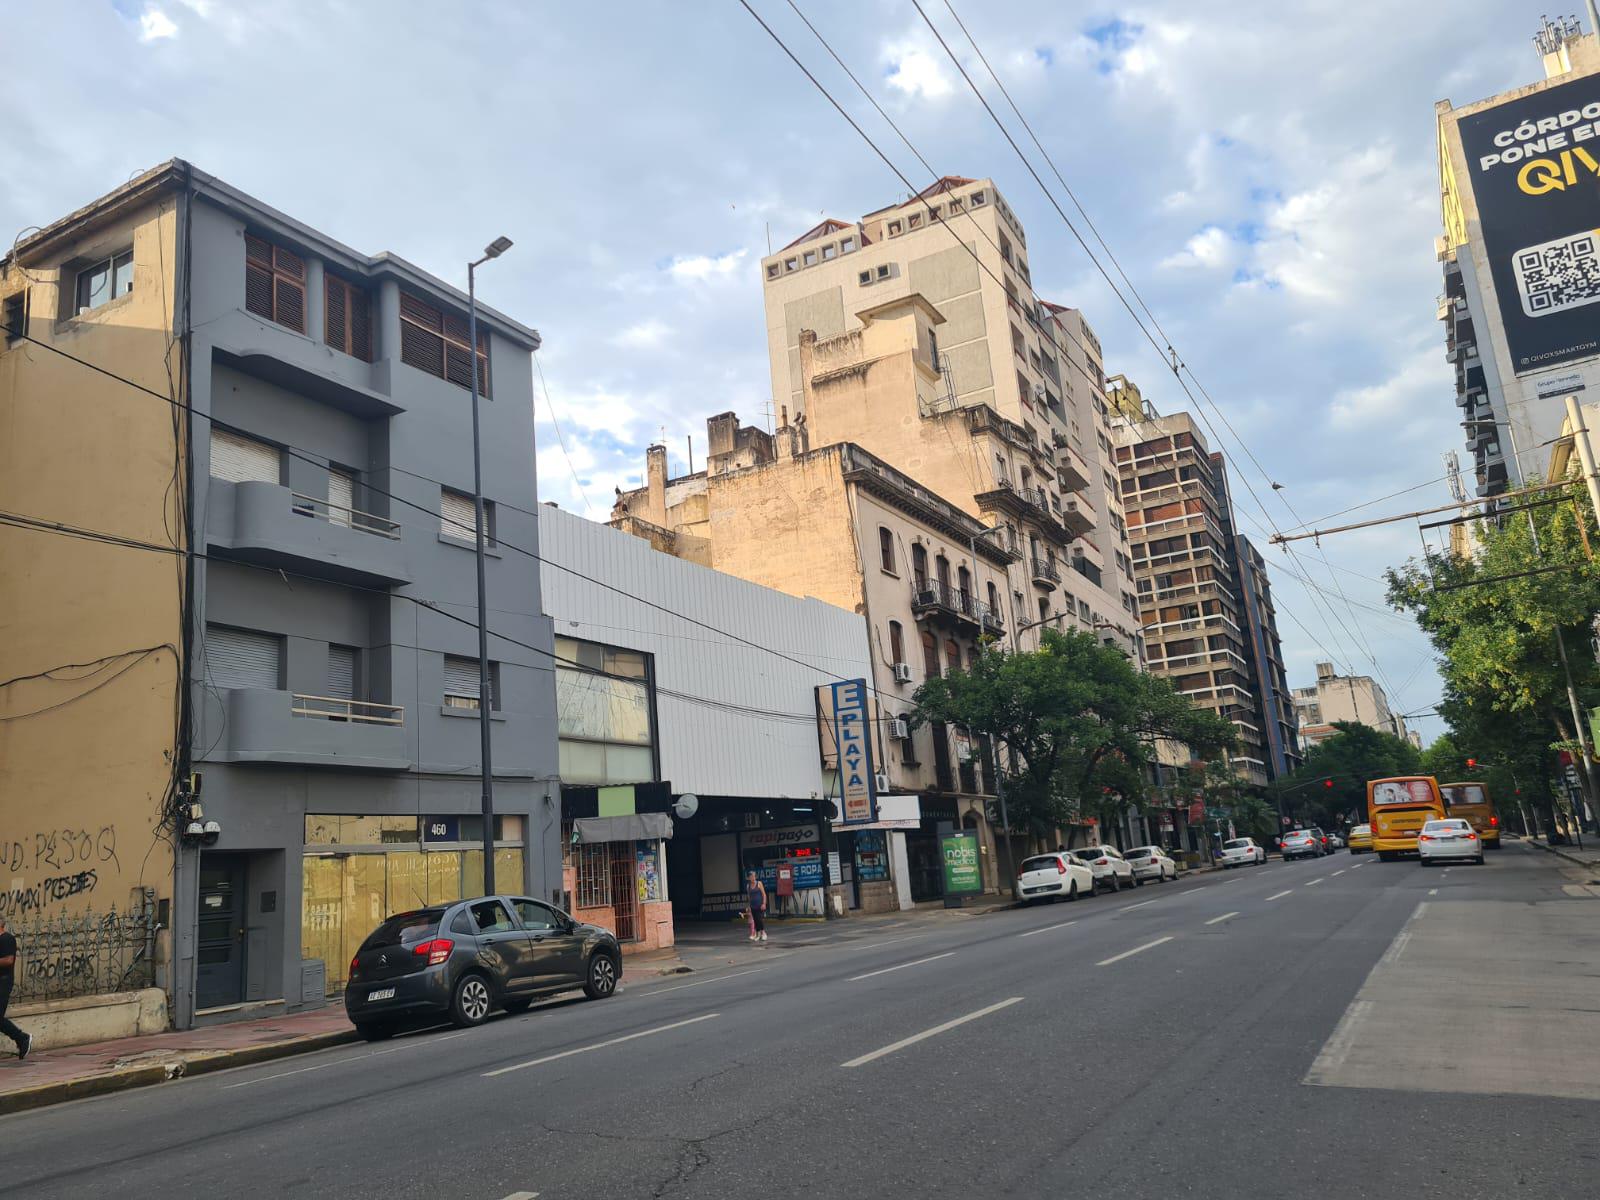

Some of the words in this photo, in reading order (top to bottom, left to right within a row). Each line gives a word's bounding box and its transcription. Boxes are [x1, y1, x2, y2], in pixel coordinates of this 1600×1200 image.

[1493, 102, 1600, 148] CÓRDO
[1479, 131, 1568, 172] PONE
[431, 823, 447, 835] 460
[946, 846, 976, 859] nobis
[801, 864, 823, 876] ROPA
